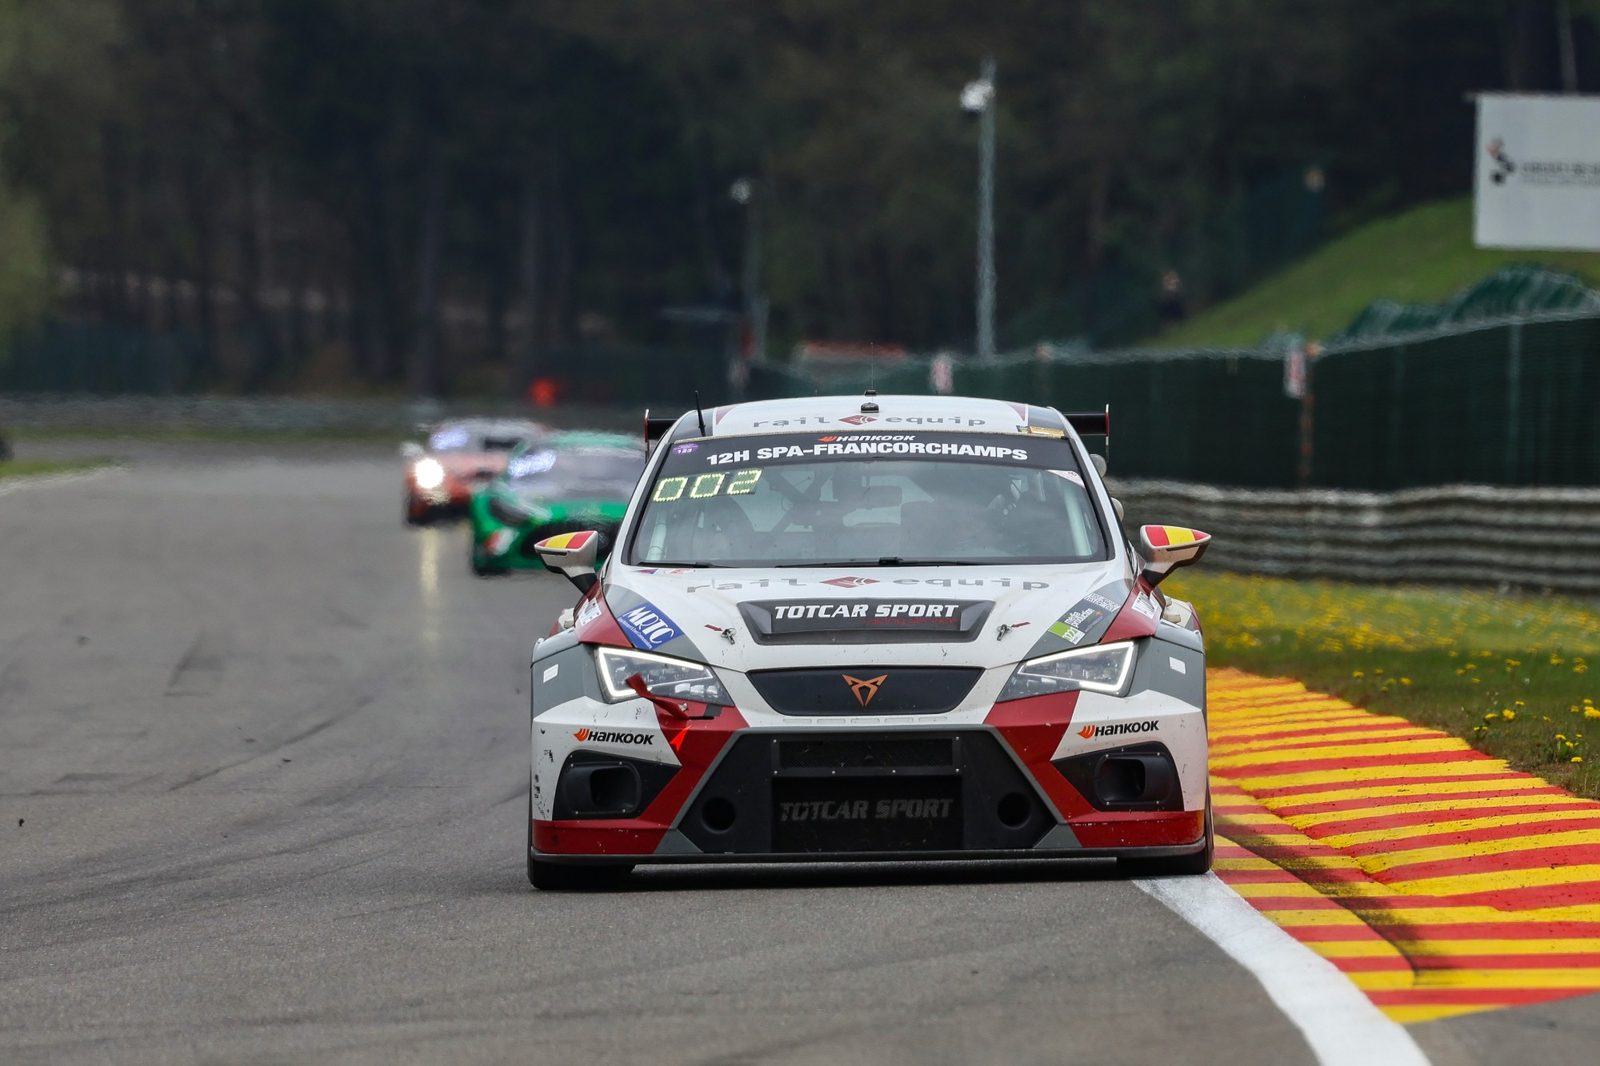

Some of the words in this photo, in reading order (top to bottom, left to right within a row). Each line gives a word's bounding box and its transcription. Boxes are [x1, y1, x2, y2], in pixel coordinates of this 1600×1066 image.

[753, 416, 830, 427] rail
[885, 416, 986, 427] equip
[707, 450, 750, 465] 12H
[757, 442, 1028, 461] SPA-FRANCORCHAMPS
[653, 469, 762, 502] 002
[687, 578, 807, 593] rail
[893, 578, 1050, 591] equip
[775, 604, 869, 619] TOTCAR
[875, 604, 959, 618] SPORT
[622, 606, 675, 644] MRTC
[1094, 720, 1159, 737] HANKOOK
[588, 731, 654, 745] HANKOOK
[779, 800, 869, 822] TOTCAR
[875, 799, 954, 819] SPORT
